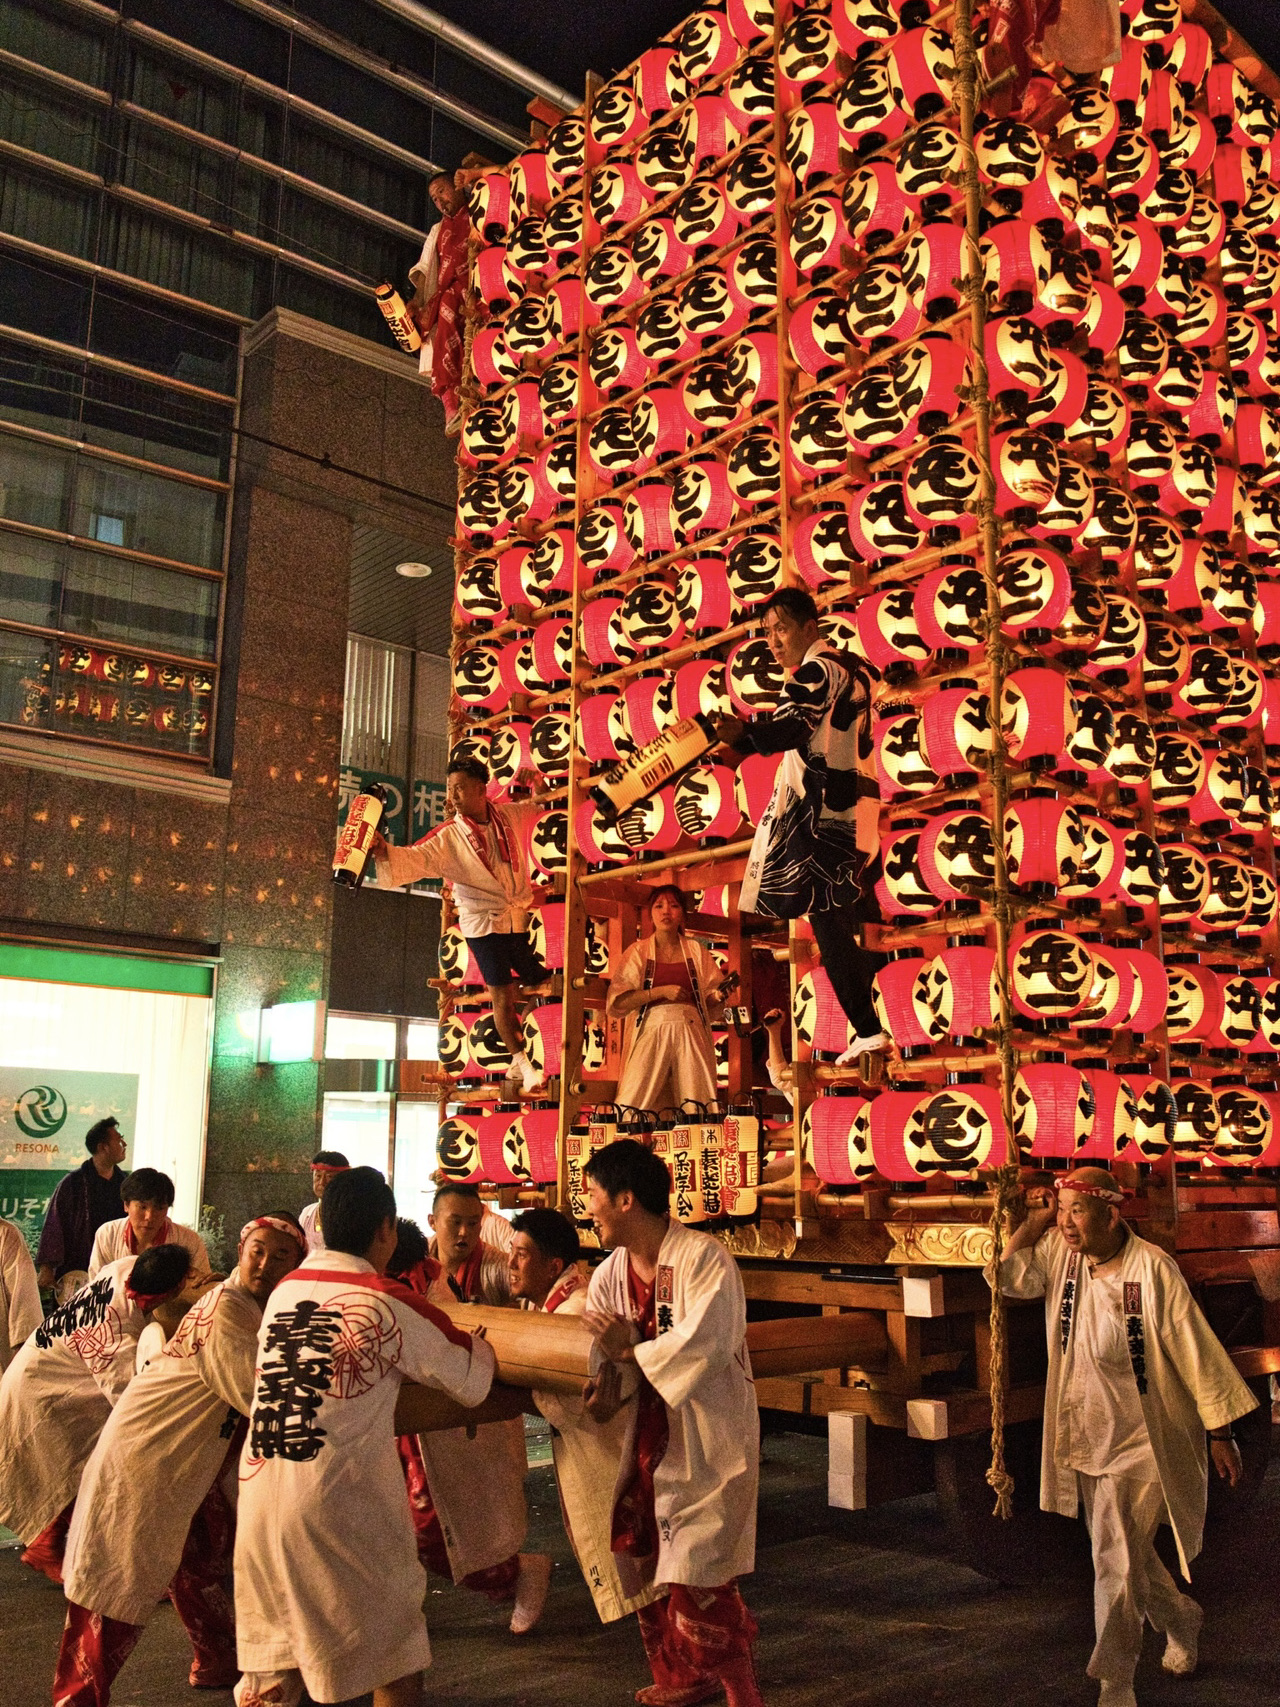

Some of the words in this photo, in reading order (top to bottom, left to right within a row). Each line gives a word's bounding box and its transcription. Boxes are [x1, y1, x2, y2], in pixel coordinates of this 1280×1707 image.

[15, 1143, 59, 1154] RESONA
[2, 1196, 50, 1219] りそ
[589, 1565, 603, 1588] 川又
